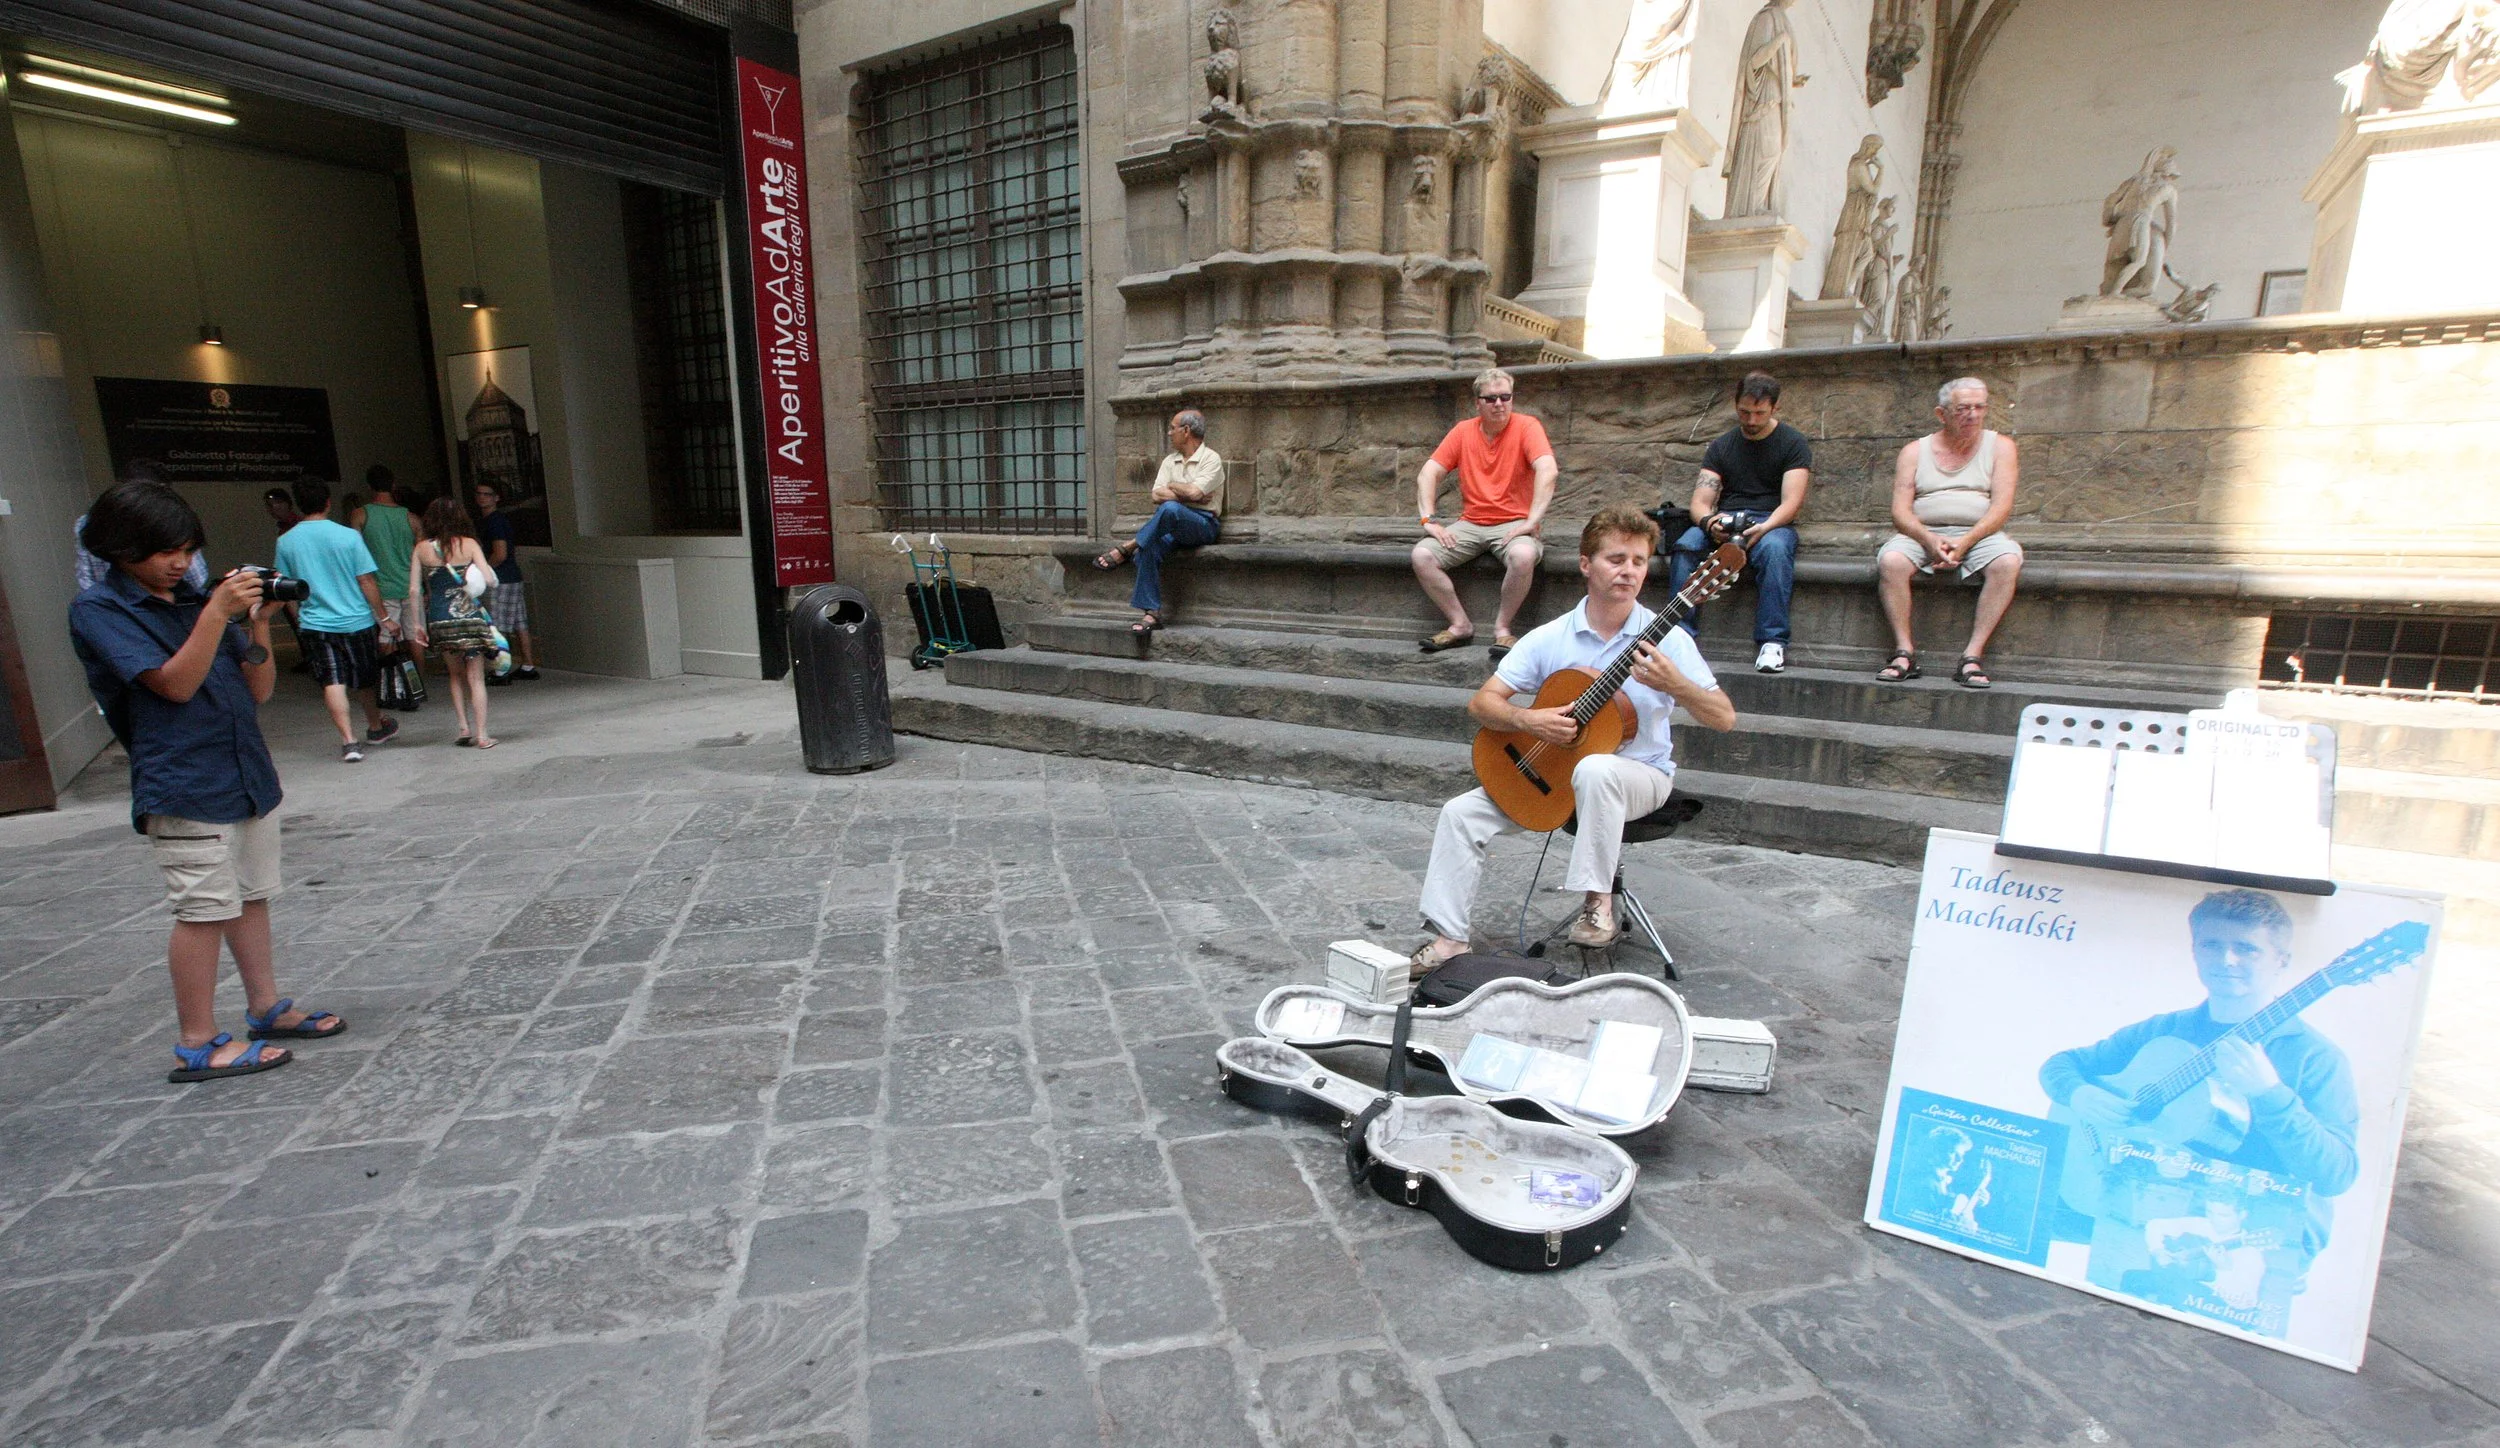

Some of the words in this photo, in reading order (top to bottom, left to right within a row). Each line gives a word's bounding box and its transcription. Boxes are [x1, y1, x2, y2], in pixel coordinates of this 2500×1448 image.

[783, 163, 800, 209] Uffizi
[785, 210, 804, 257] degli
[760, 157, 808, 465] AperitivoAdArte
[790, 261, 808, 327] Galleria
[795, 332, 810, 362] alla
[168, 449, 227, 461] Gabinetto
[229, 450, 290, 463] Fotografico
[225, 462, 237, 473] of
[238, 462, 304, 475] Photography
[2196, 719, 2272, 737] ORIGINAL
[2278, 725, 2300, 739] CD
[1950, 866, 2064, 904] Tadeusz
[1925, 898, 2077, 942] Machalski
